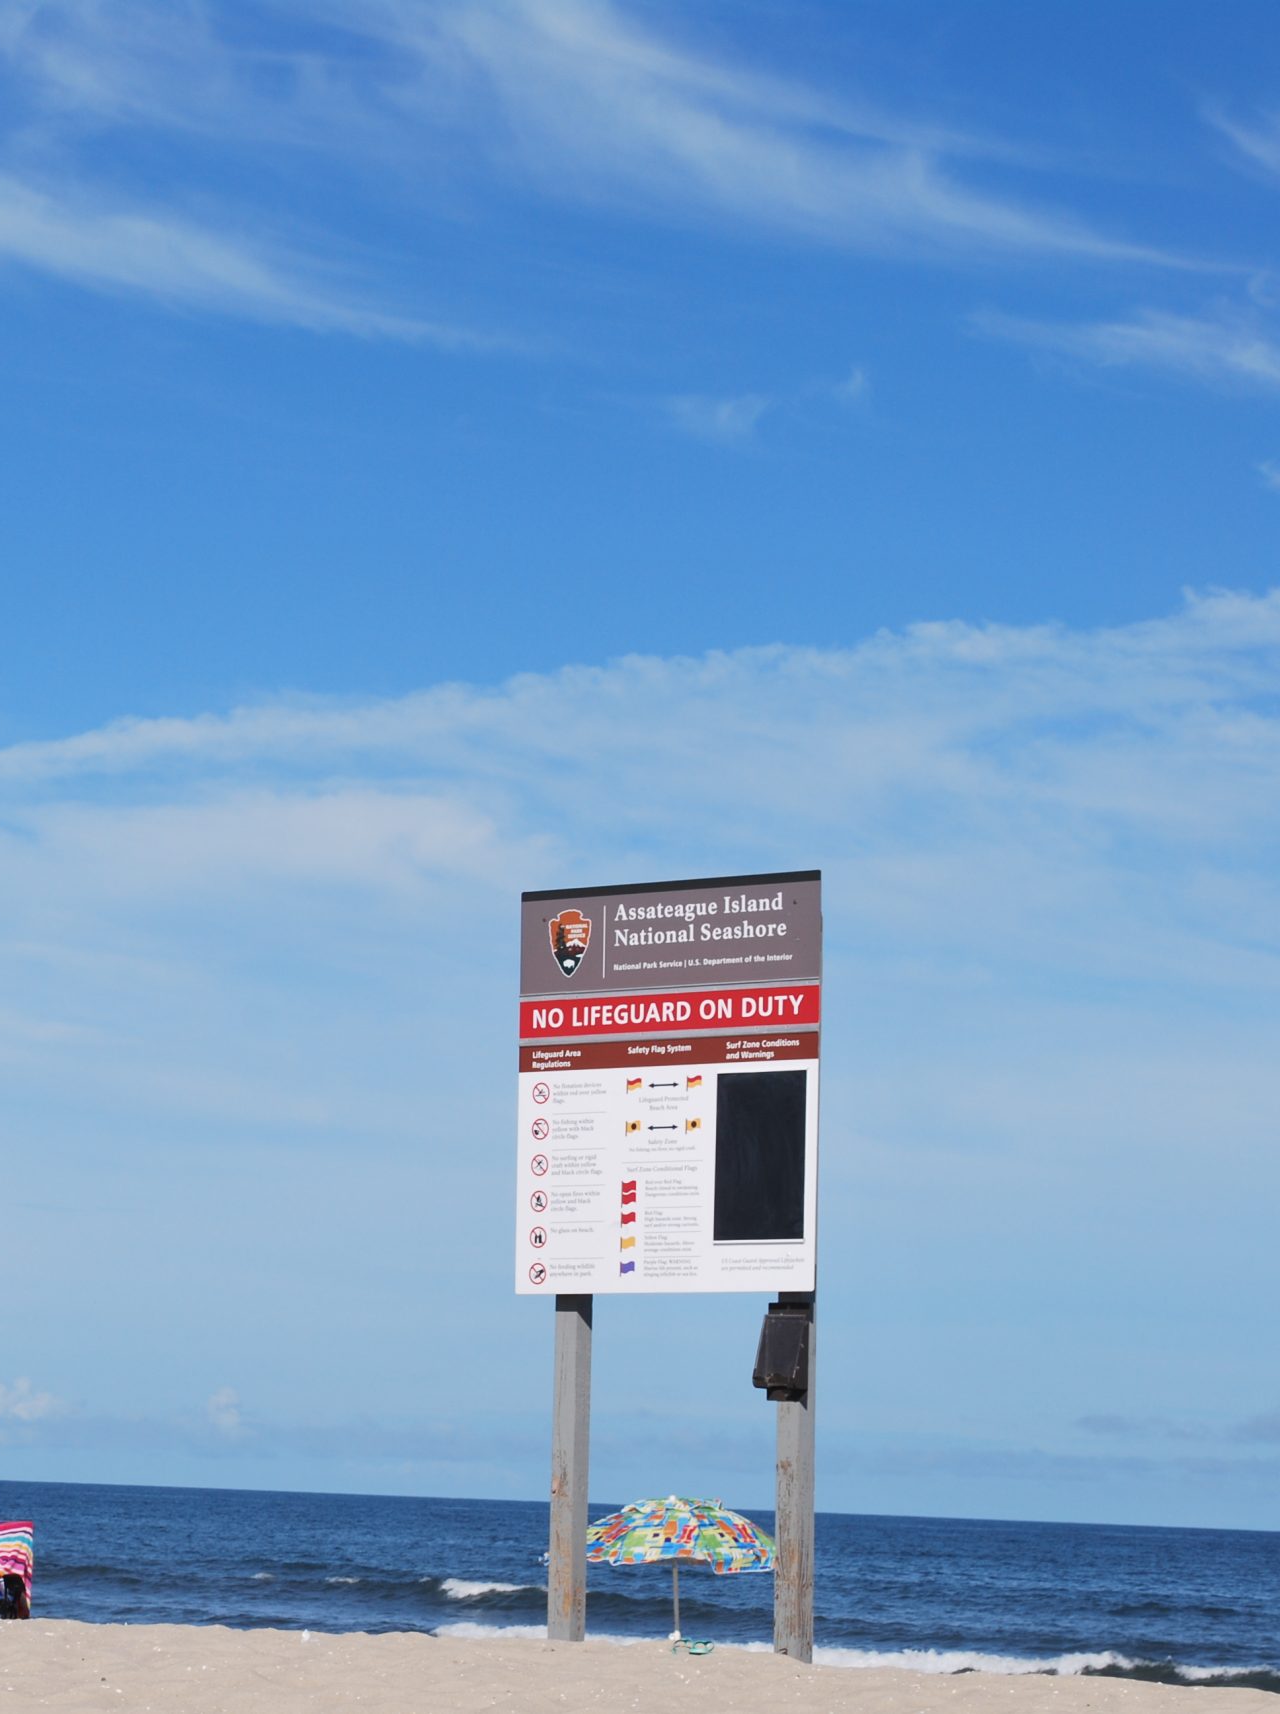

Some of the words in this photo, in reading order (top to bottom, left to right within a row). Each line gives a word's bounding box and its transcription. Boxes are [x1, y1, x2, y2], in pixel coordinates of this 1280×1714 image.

[614, 902, 718, 922] Assateague
[723, 892, 783, 914] Island
[614, 925, 695, 947] National
[700, 921, 787, 942] Seashore
[613, 962, 641, 972] National
[643, 961, 658, 969] Park
[659, 960, 683, 969] Service
[688, 959, 701, 967] U.S.
[703, 956, 743, 967] Department
[745, 955, 752, 963] of
[767, 953, 793, 961] Interior
[532, 1008, 564, 1029] NO
[572, 1000, 691, 1027] LIFEGUARD
[699, 998, 733, 1020] ON
[741, 994, 804, 1017] DUTY
[627, 1045, 650, 1056] Safety
[651, 1045, 666, 1055] Flag
[667, 1044, 692, 1054] System
[726, 1041, 742, 1050] Surf
[743, 1040, 760, 1049] Zone
[762, 1038, 800, 1048] Conditions
[532, 1050, 564, 1060] Lifeguard
[564, 1049, 582, 1058] Area
[726, 1051, 740, 1059] and
[741, 1049, 775, 1060] Warnings
[532, 1059, 571, 1070] Regulations
